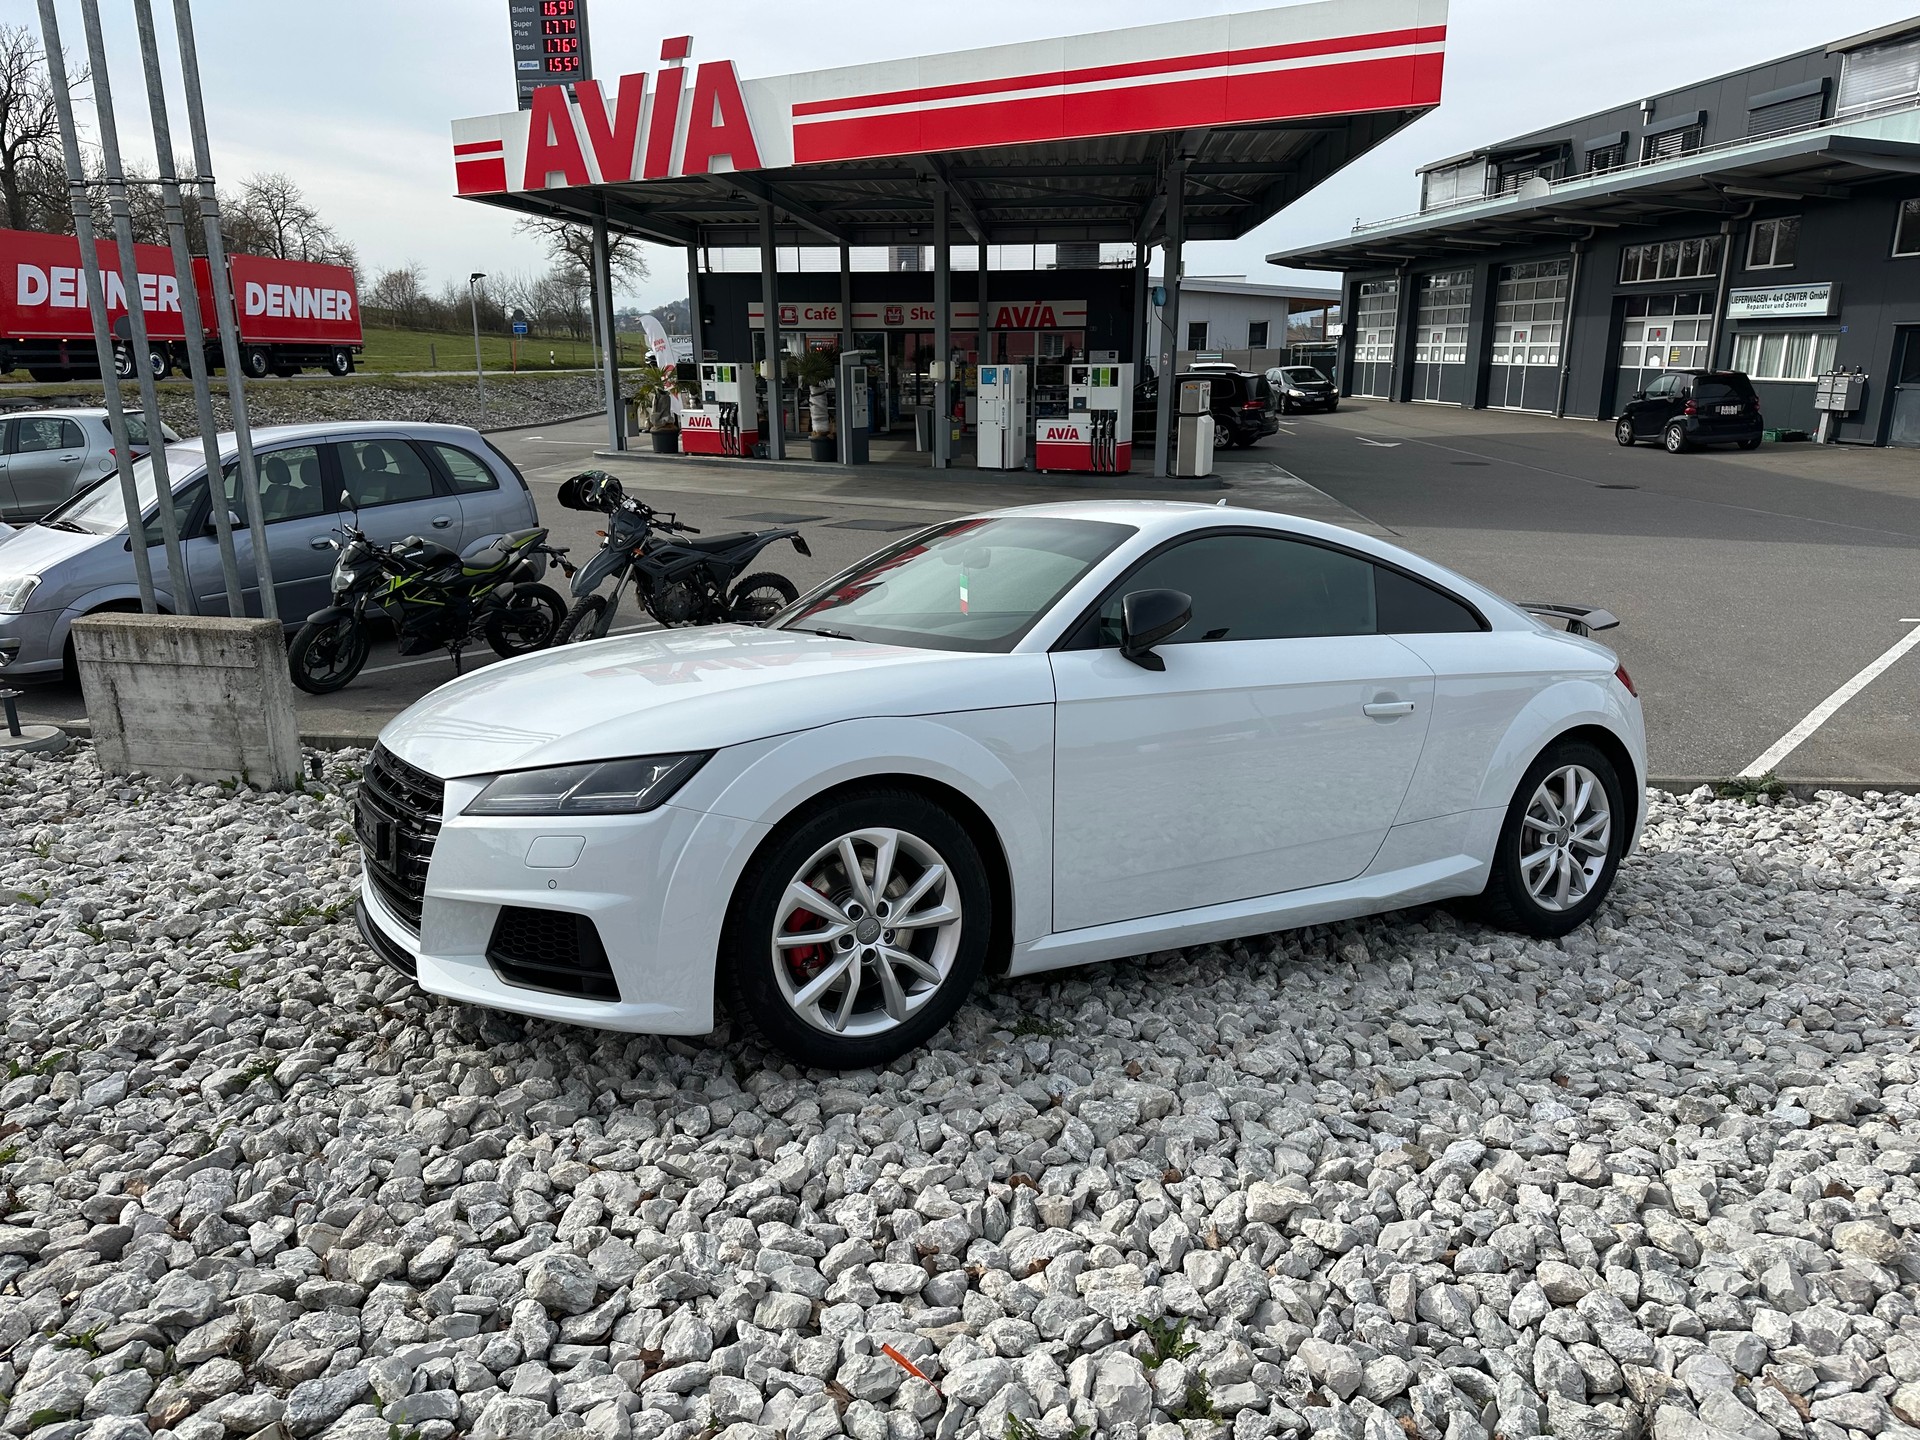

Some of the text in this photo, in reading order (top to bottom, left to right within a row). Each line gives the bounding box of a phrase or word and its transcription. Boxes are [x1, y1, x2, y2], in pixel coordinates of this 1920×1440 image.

[523, 36, 763, 190] AVIA
[246, 282, 352, 321] DENNER
[1732, 294, 1768, 304] LIEFERWAGEN
[1784, 292, 1807, 301] CENTER
[1810, 290, 1828, 300] GmbH
[804, 306, 836, 320] Café
[994, 300, 1057, 327] AVIA
[689, 415, 712, 427] AVIA
[1047, 425, 1079, 440] AVIA
